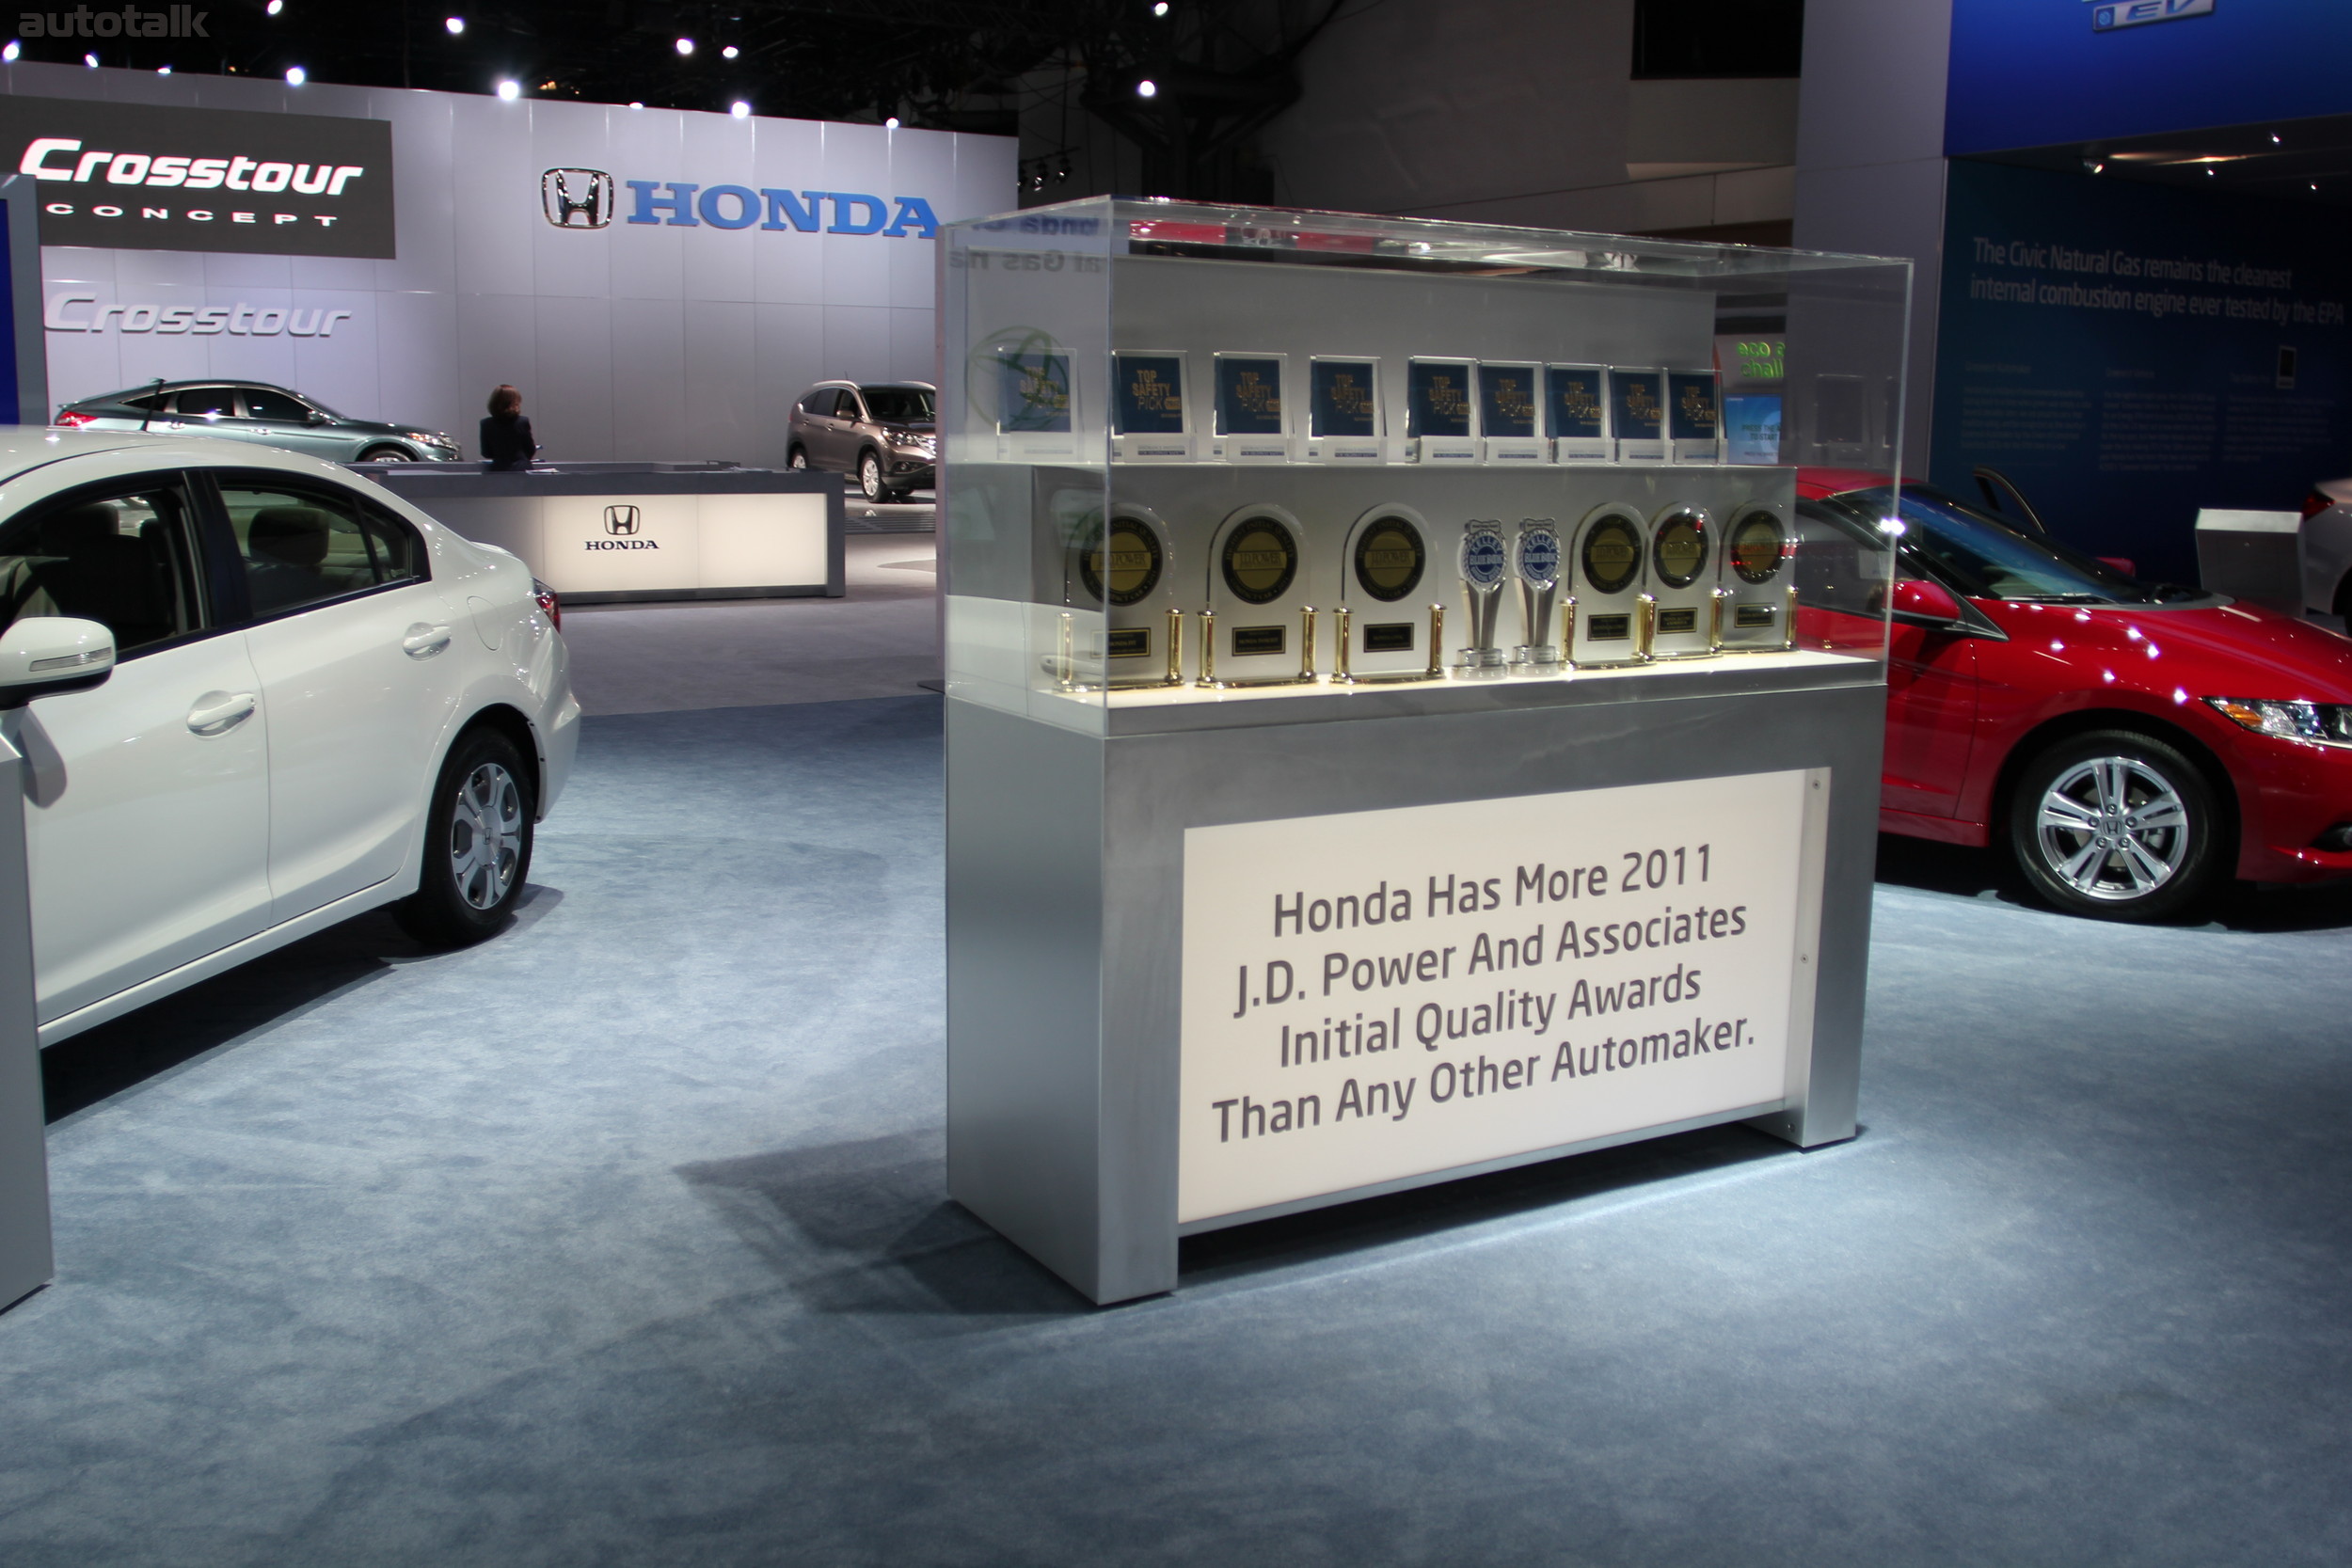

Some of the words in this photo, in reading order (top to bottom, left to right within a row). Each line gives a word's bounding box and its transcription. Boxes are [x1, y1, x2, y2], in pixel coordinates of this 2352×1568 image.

[19, 137, 363, 196] Crosstour
[46, 203, 338, 227] CONCEPT
[627, 180, 937, 239] HONDA
[1973, 237, 2006, 265] The
[2010, 241, 2046, 269] Civic
[2050, 245, 2109, 275] Natural
[2113, 250, 2141, 277] Gas
[2144, 256, 2203, 281] remains
[2208, 260, 2231, 284] the
[2233, 262, 2293, 290] cleanest
[43, 291, 352, 338] Crosstour
[1970, 273, 2035, 303] internal
[2039, 279, 2131, 310] combustion
[2135, 289, 2185, 318] engine
[2188, 295, 2222, 315] ever
[2224, 295, 2270, 321] tested
[2272, 298, 2290, 326] by
[2293, 301, 2315, 324] the
[2317, 302, 2344, 325] EPA
[1737, 341, 1771, 357] eco
[1132, 383, 1170, 396] SAFETY
[1136, 369, 1158, 383] TOP
[1137, 396, 1163, 410] PICK
[584, 540, 660, 551] HONDA
[1472, 536, 1502, 552] KELLEY
[1527, 534, 1558, 550] KELLEY
[1274, 881, 1412, 938] Honda
[1427, 874, 1502, 918] Has
[1516, 863, 1609, 907] More
[1621, 844, 1710, 893] 2011
[1233, 958, 1308, 1019] J.D.
[1323, 941, 1456, 997] Power
[1468, 924, 1545, 975] And
[1557, 905, 1748, 963] Associates
[1280, 1007, 1402, 1068] Initial
[1415, 988, 1557, 1053] Quality
[1568, 963, 1702, 1020] Awards
[1212, 1094, 1320, 1144] Than
[1335, 1073, 1417, 1122] Any
[1430, 1051, 1541, 1104] Other
[1551, 1016, 1756, 1084] Automaker.
